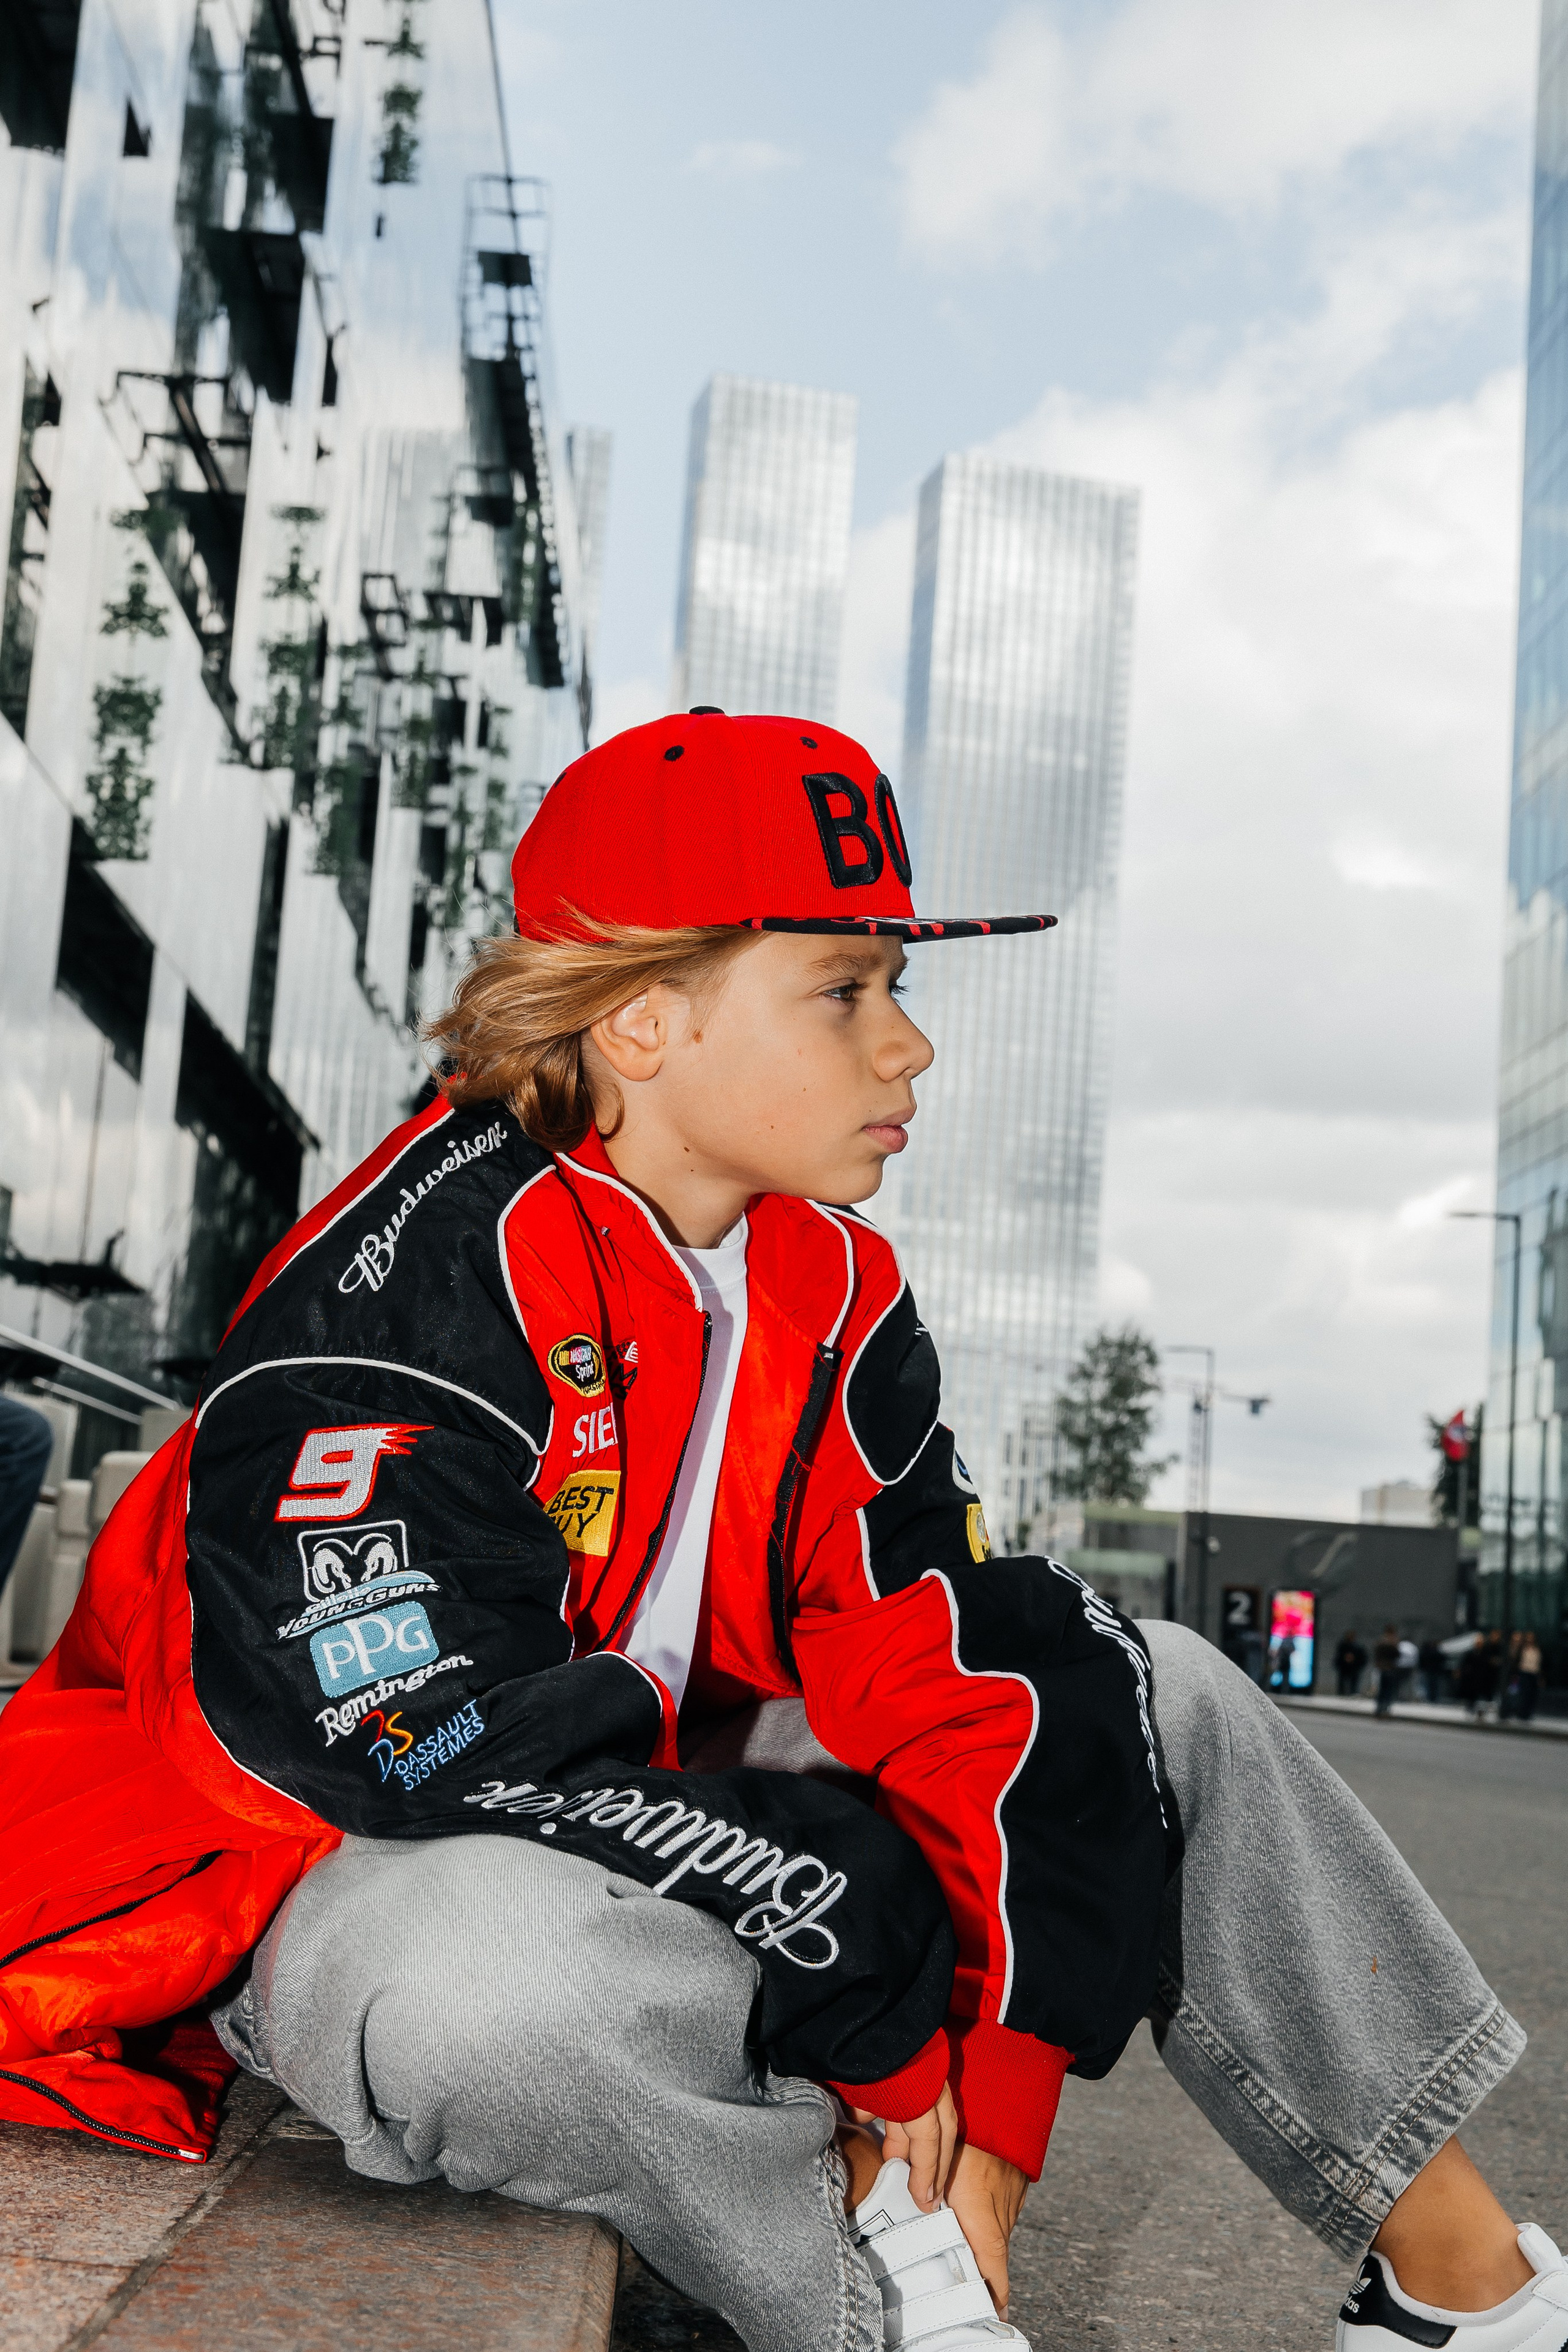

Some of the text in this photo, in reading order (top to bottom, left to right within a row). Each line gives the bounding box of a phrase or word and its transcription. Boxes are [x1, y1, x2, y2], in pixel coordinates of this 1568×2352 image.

[338, 1121, 507, 1294] Budweiser
[575, 1361, 594, 1382] Sprint
[572, 1402, 618, 1458] SIE
[274, 1423, 434, 1523] 9
[548, 1485, 614, 1515] BEST
[549, 1513, 598, 1538] UY
[1227, 1592, 1251, 1624] 2
[322, 1613, 430, 1680] PPG
[315, 1654, 473, 1747] Remington
[394, 1699, 477, 1775] DASSAULT
[403, 1717, 485, 1791] SYSTEMES
